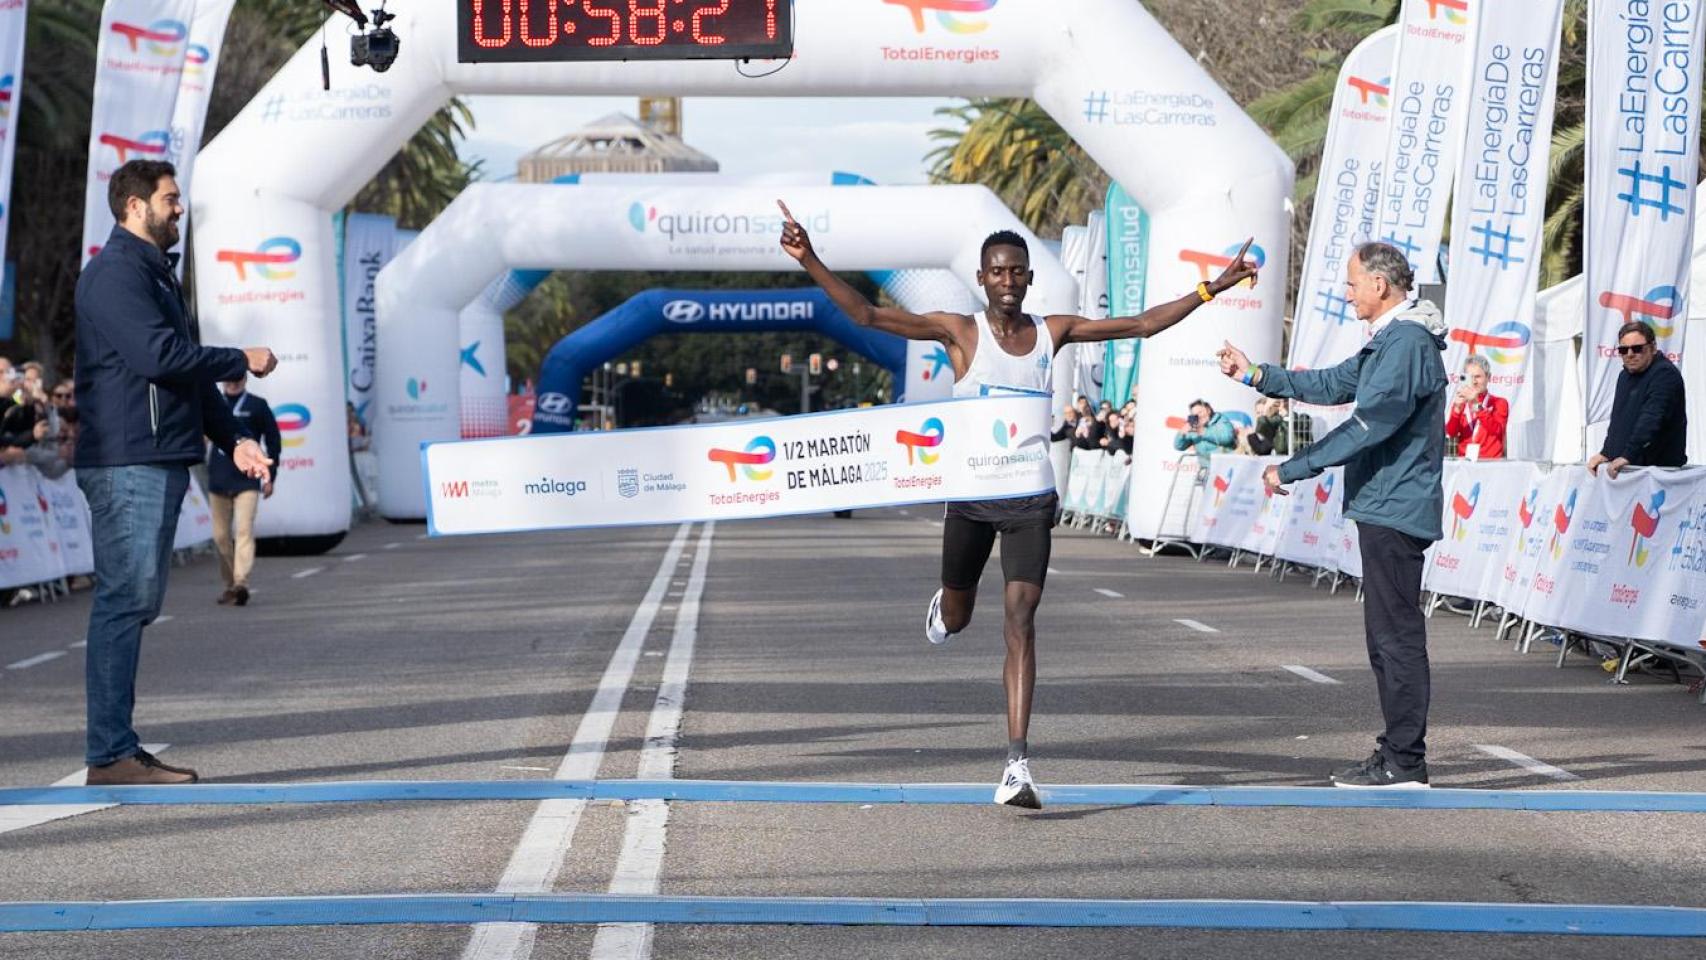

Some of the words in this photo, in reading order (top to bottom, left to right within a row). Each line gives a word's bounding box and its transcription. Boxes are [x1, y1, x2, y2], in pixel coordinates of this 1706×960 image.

[1406, 23, 1466, 44] TotalEnergi
[879, 44, 1000, 64] TotalEnergies
[1654, 0, 1691, 156] LasCarre
[1113, 108, 1217, 127] LasCarreras
[1502, 47, 1546, 216] LasCarreras
[1405, 84, 1454, 229] LasCarreras
[657, 209, 830, 241] quirónsad
[708, 301, 814, 321] HYUNDAI
[350, 250, 382, 393] CaixaBank
[783, 440, 805, 460] 1/2
[807, 429, 872, 458] MARATÓN
[643, 473, 674, 482] Ciudad
[787, 470, 807, 489] DE
[809, 463, 863, 488] MÁLAGA
[863, 460, 888, 482] 2025
[894, 474, 943, 490] TotalEnergies
[524, 476, 587, 496] málaga
[656, 482, 687, 493] Málaga
[709, 490, 780, 505] TotalEnergies
